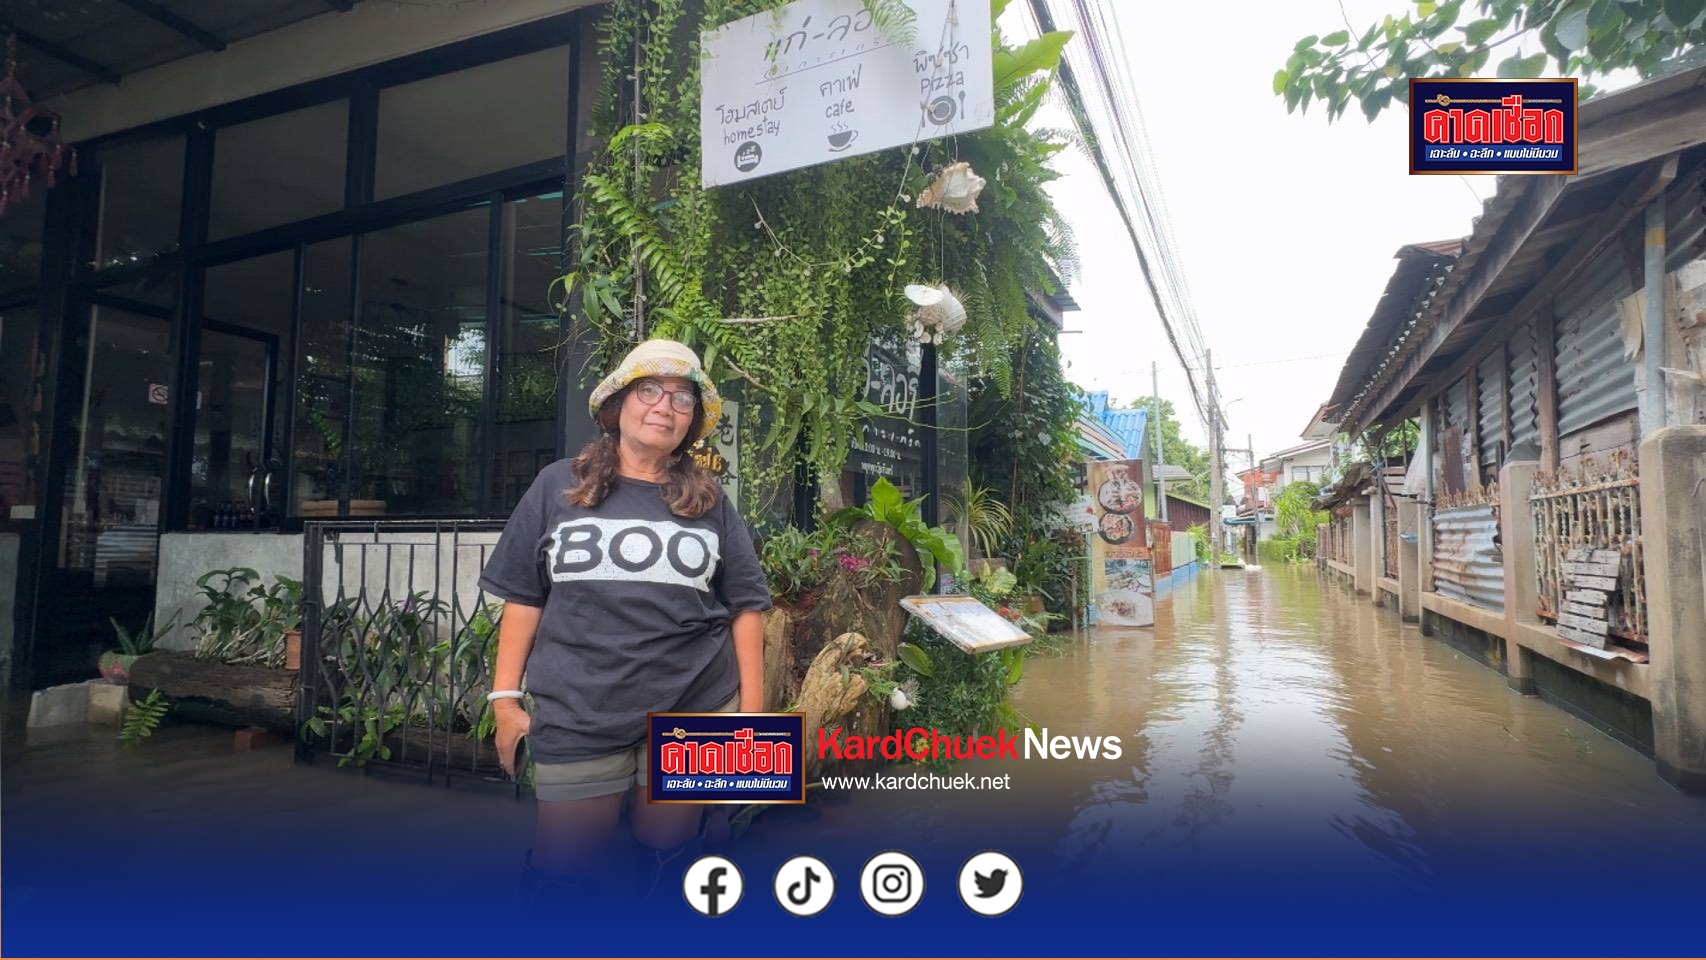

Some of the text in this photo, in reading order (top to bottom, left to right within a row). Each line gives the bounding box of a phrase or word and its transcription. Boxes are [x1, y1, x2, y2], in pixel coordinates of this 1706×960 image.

[819, 63, 862, 97] คาเฟ่
[825, 98, 855, 118] cafe
[723, 115, 781, 145] homestay
[553, 524, 711, 578] BOO
